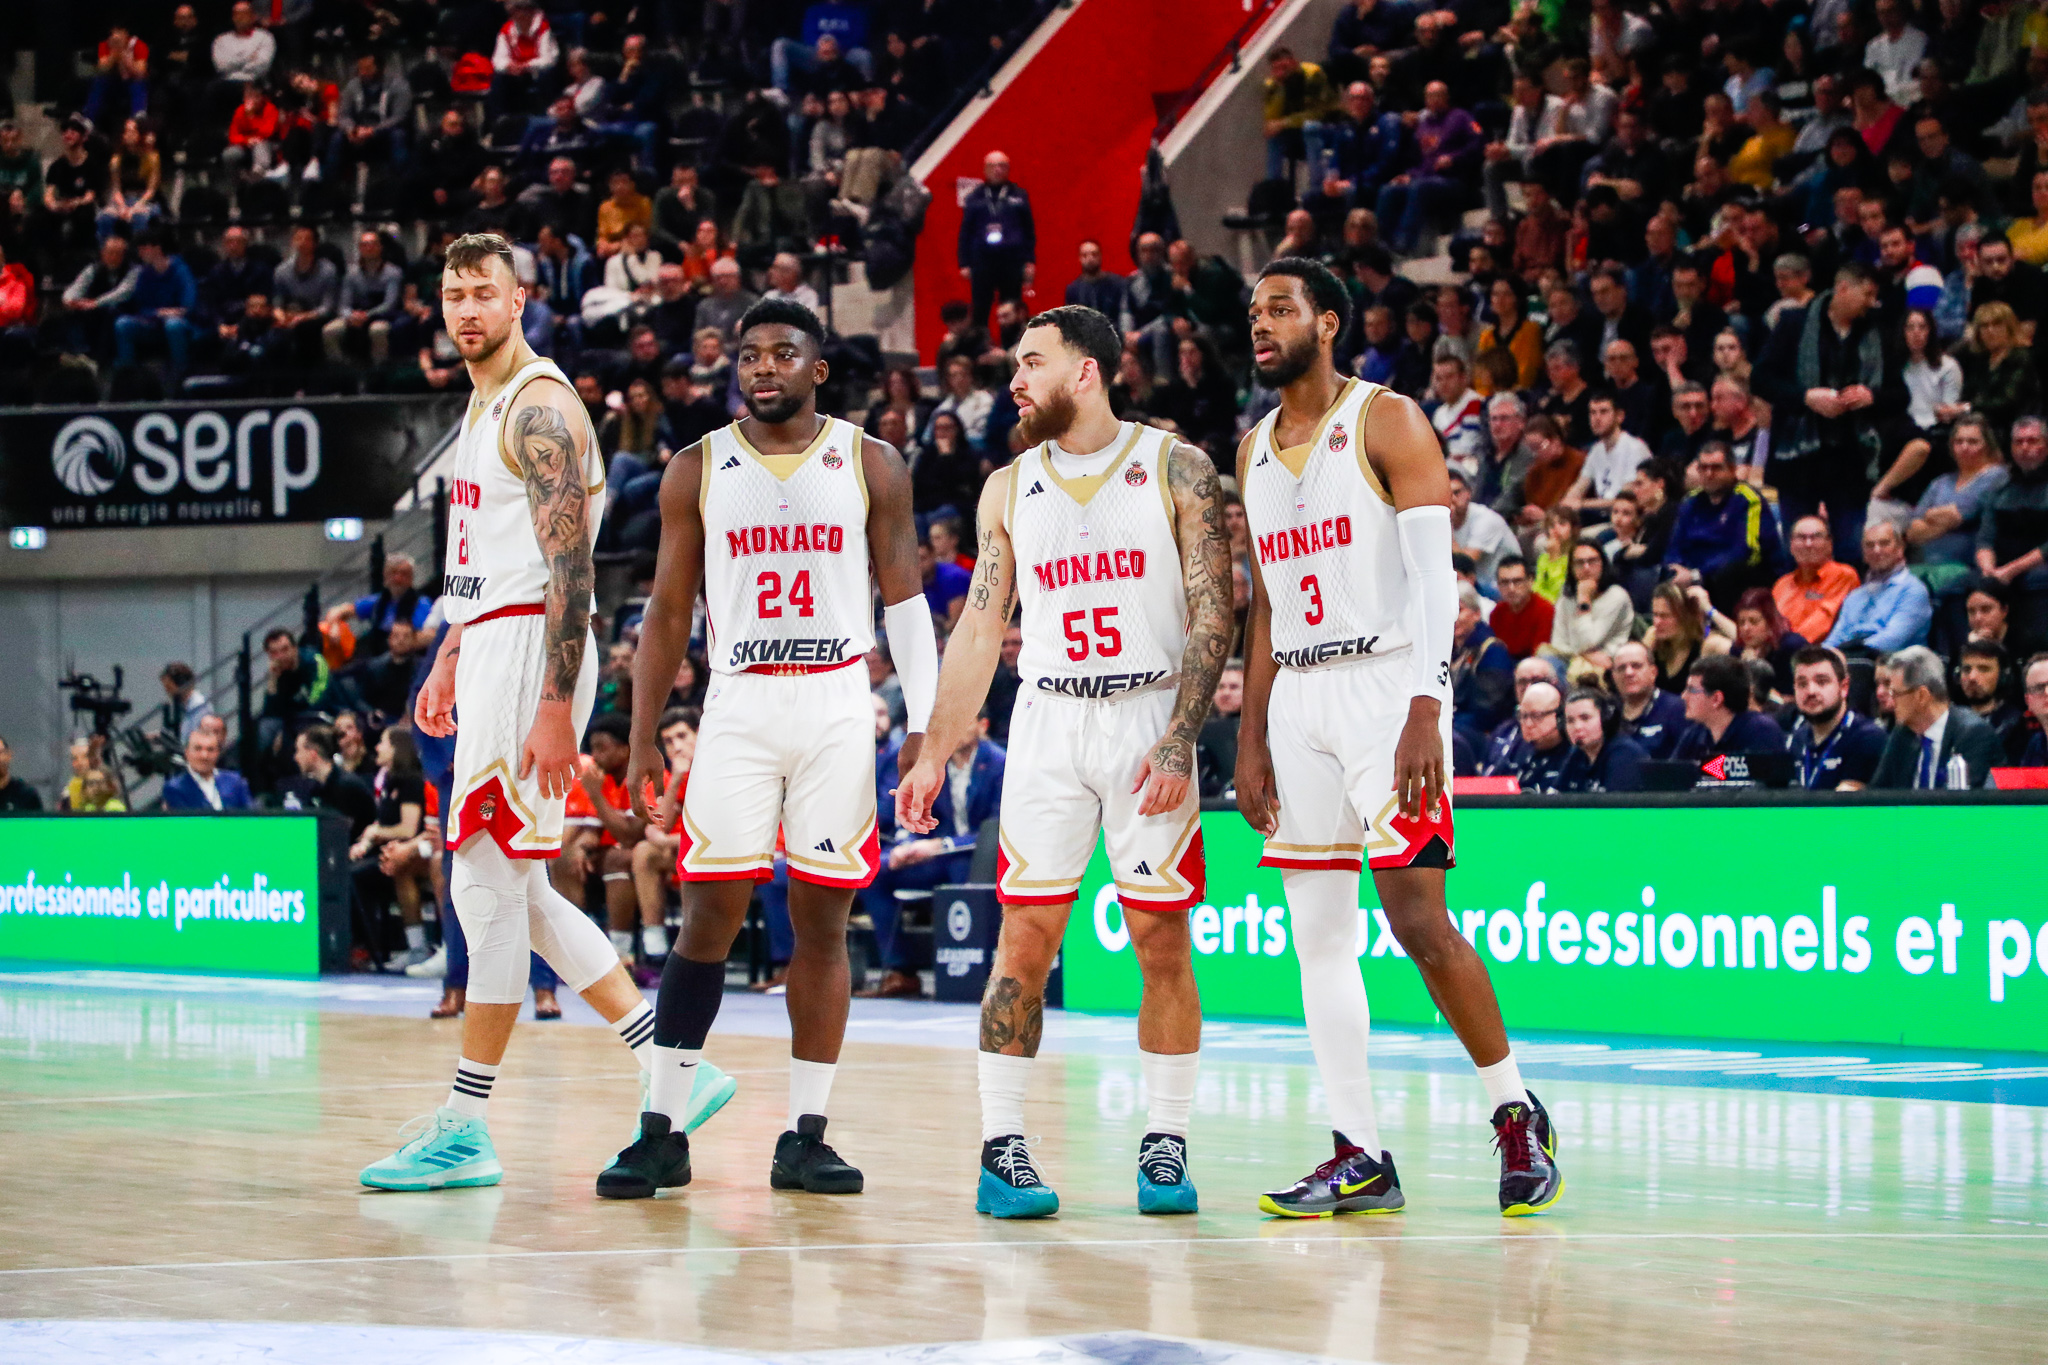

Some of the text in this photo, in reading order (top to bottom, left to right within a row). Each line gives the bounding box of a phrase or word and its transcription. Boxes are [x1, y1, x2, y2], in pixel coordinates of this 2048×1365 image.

[131, 407, 320, 517] serp
[726, 523, 844, 560] MONACO
[1257, 514, 1353, 566] MONACO
[756, 570, 814, 620] 24
[1032, 548, 1147, 593] MONACO
[1300, 574, 1324, 626] 3
[730, 638, 851, 667] SKWEEK
[1062, 607, 1122, 662] 55
[146, 880, 170, 919] et
[174, 872, 306, 932] particuliers
[1093, 882, 1288, 957] Oerts
[1447, 880, 1873, 973] rofessionnels
[1895, 903, 1964, 975] et
